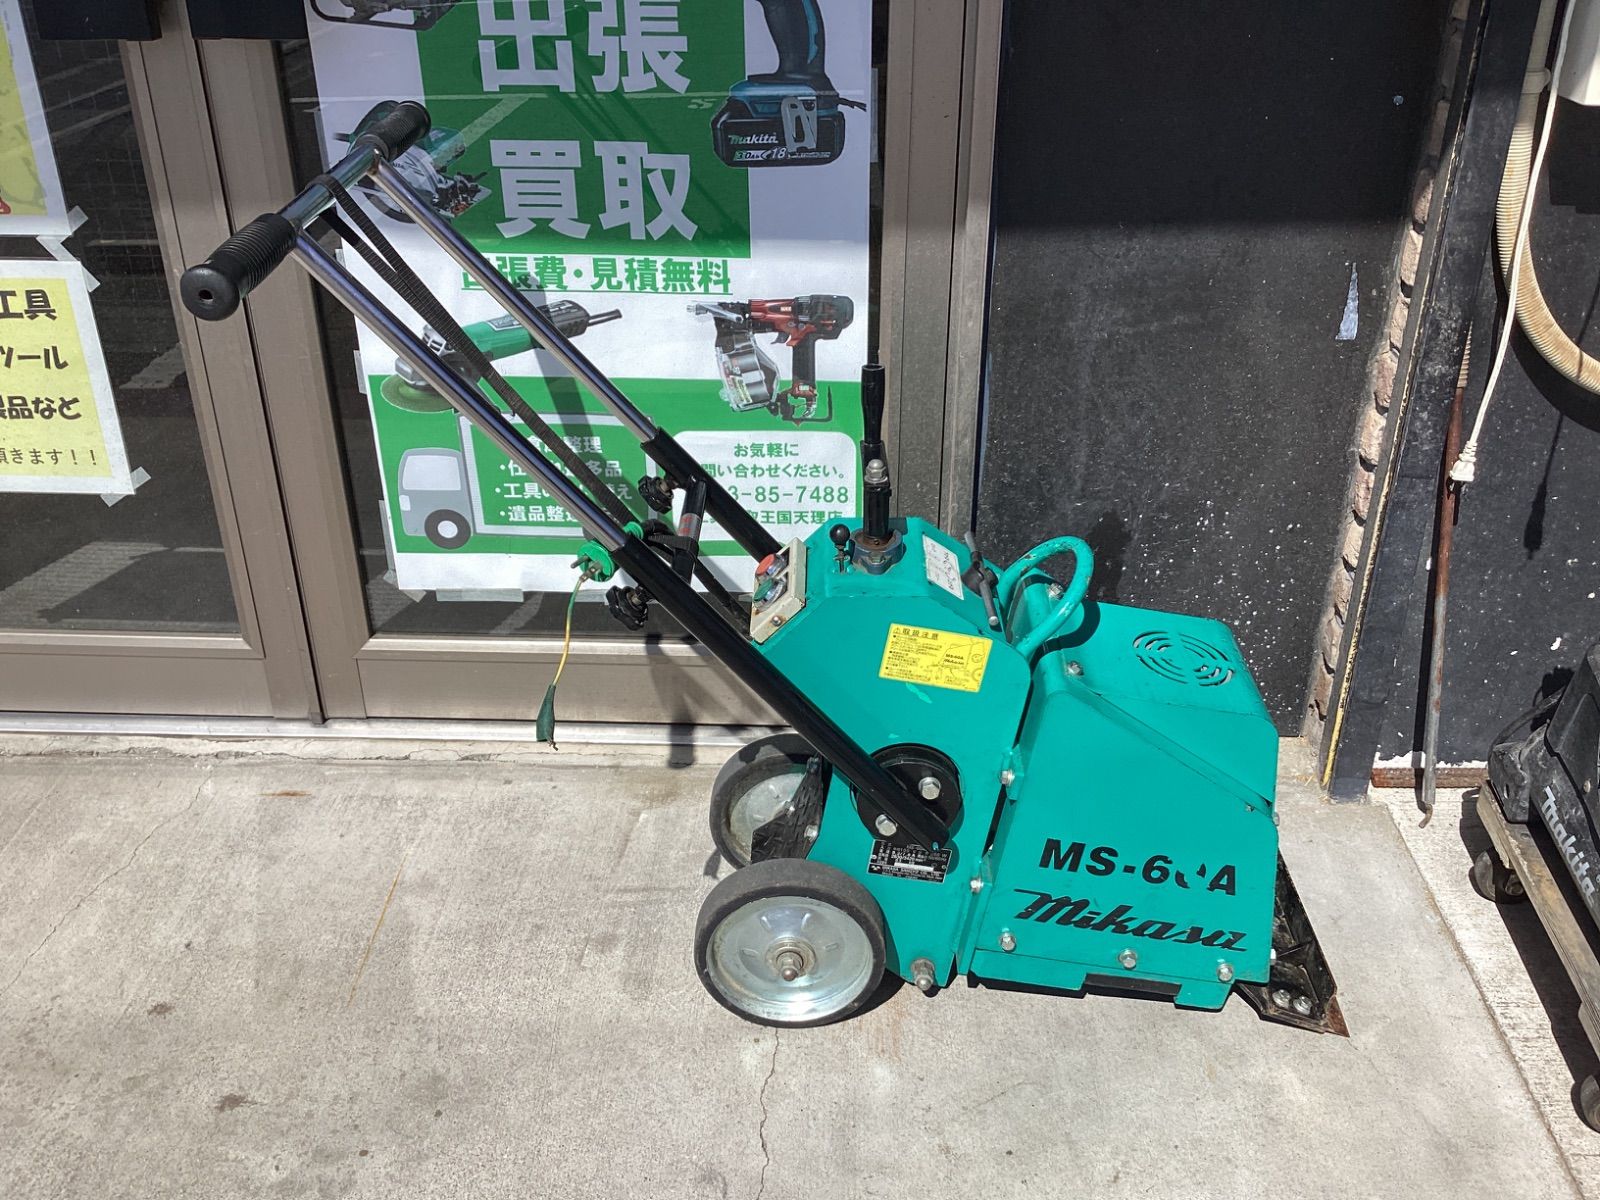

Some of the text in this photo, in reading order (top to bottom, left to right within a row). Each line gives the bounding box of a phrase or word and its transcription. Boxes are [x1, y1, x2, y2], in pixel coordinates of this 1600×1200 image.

[478, 0, 691, 95] 出張
[489, 139, 699, 241] 買取
[701, 463, 844, 478] 問い合わせください。
[734, 443, 799, 458] お気軽に
[728, 485, 849, 504] 3-85-7488
[1013, 888, 1247, 951] Mikasa
